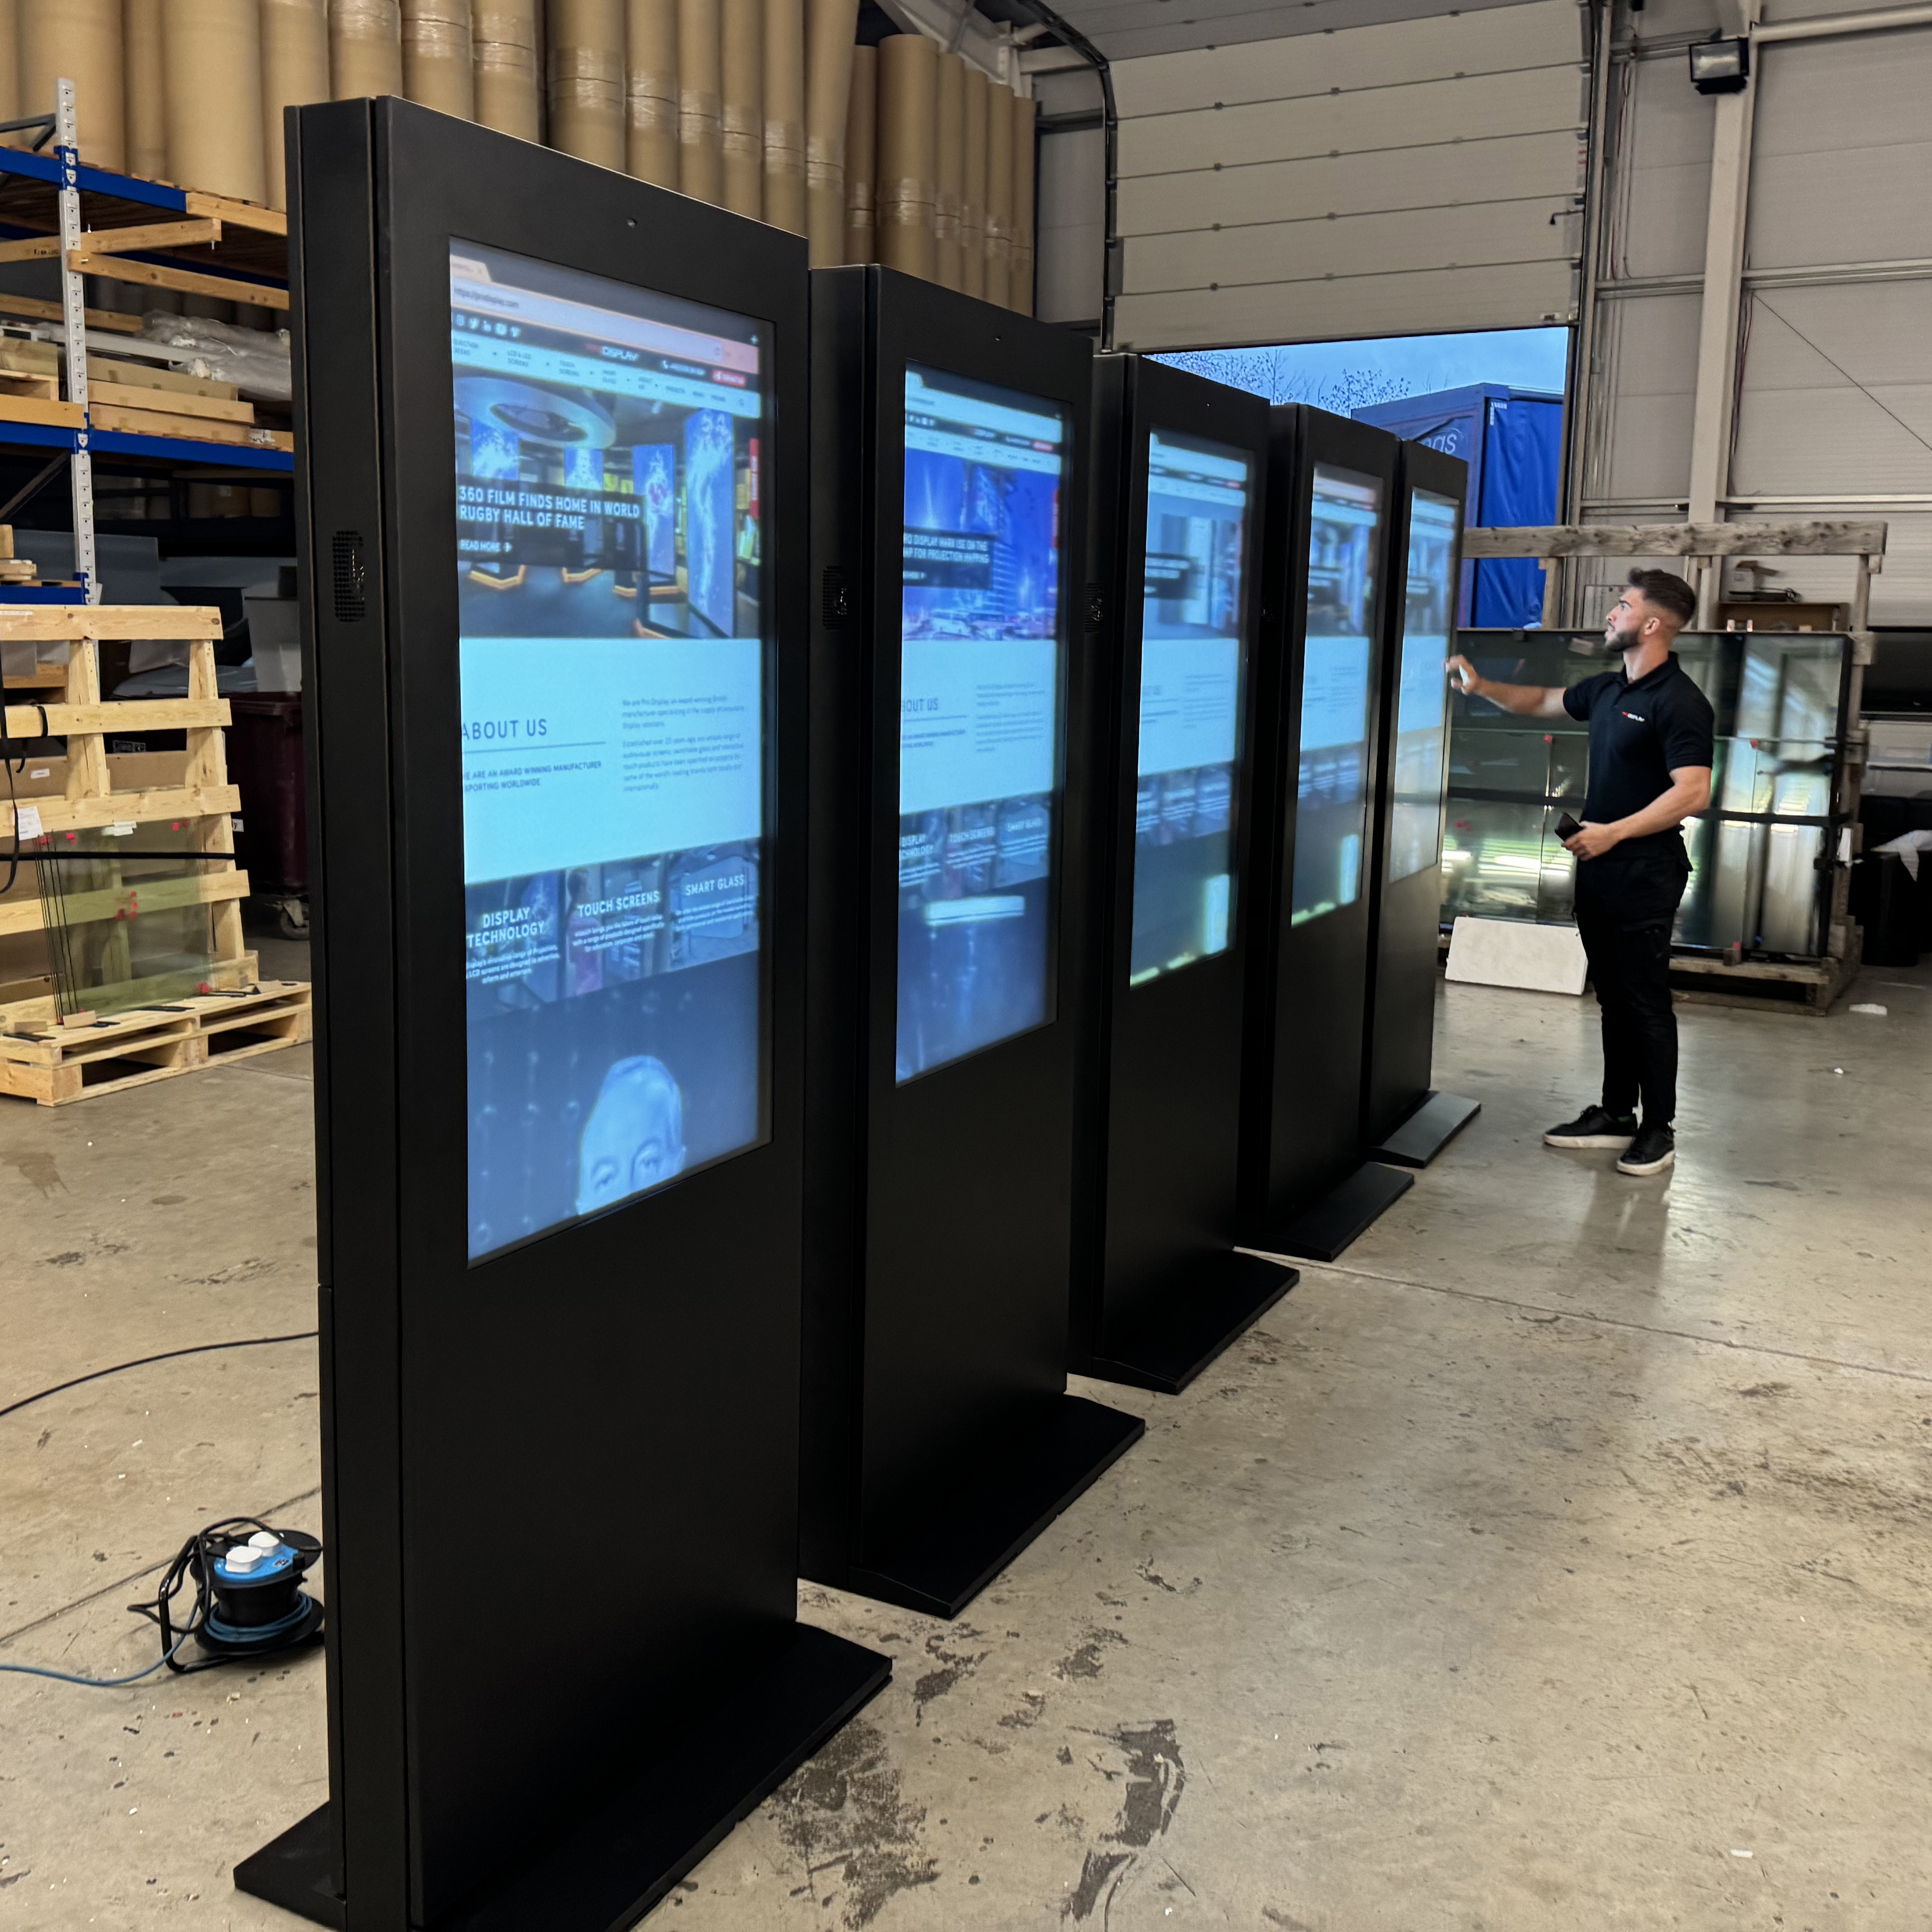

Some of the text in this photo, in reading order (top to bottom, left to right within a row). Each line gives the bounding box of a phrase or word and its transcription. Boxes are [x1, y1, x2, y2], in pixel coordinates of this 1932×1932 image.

[459, 486, 640, 518] 360 FILM FINDS HOME IN WORLD
[459, 505, 585, 530] RUGBY HALL OF FAME
[462, 719, 547, 741] ABOUT US
[472, 769, 486, 779] ARE
[487, 768, 497, 778] AN
[499, 767, 523, 777] AWARD
[524, 764, 552, 775] WINNING
[553, 760, 602, 772] MANUFACTURER
[500, 777, 541, 790] WORLDWIDE
[685, 874, 745, 896] SMART GLASS
[578, 890, 661, 918] TOUCH SCREENS
[483, 907, 530, 929] DISPLAY
[466, 921, 544, 949] TECHNOLOGY
